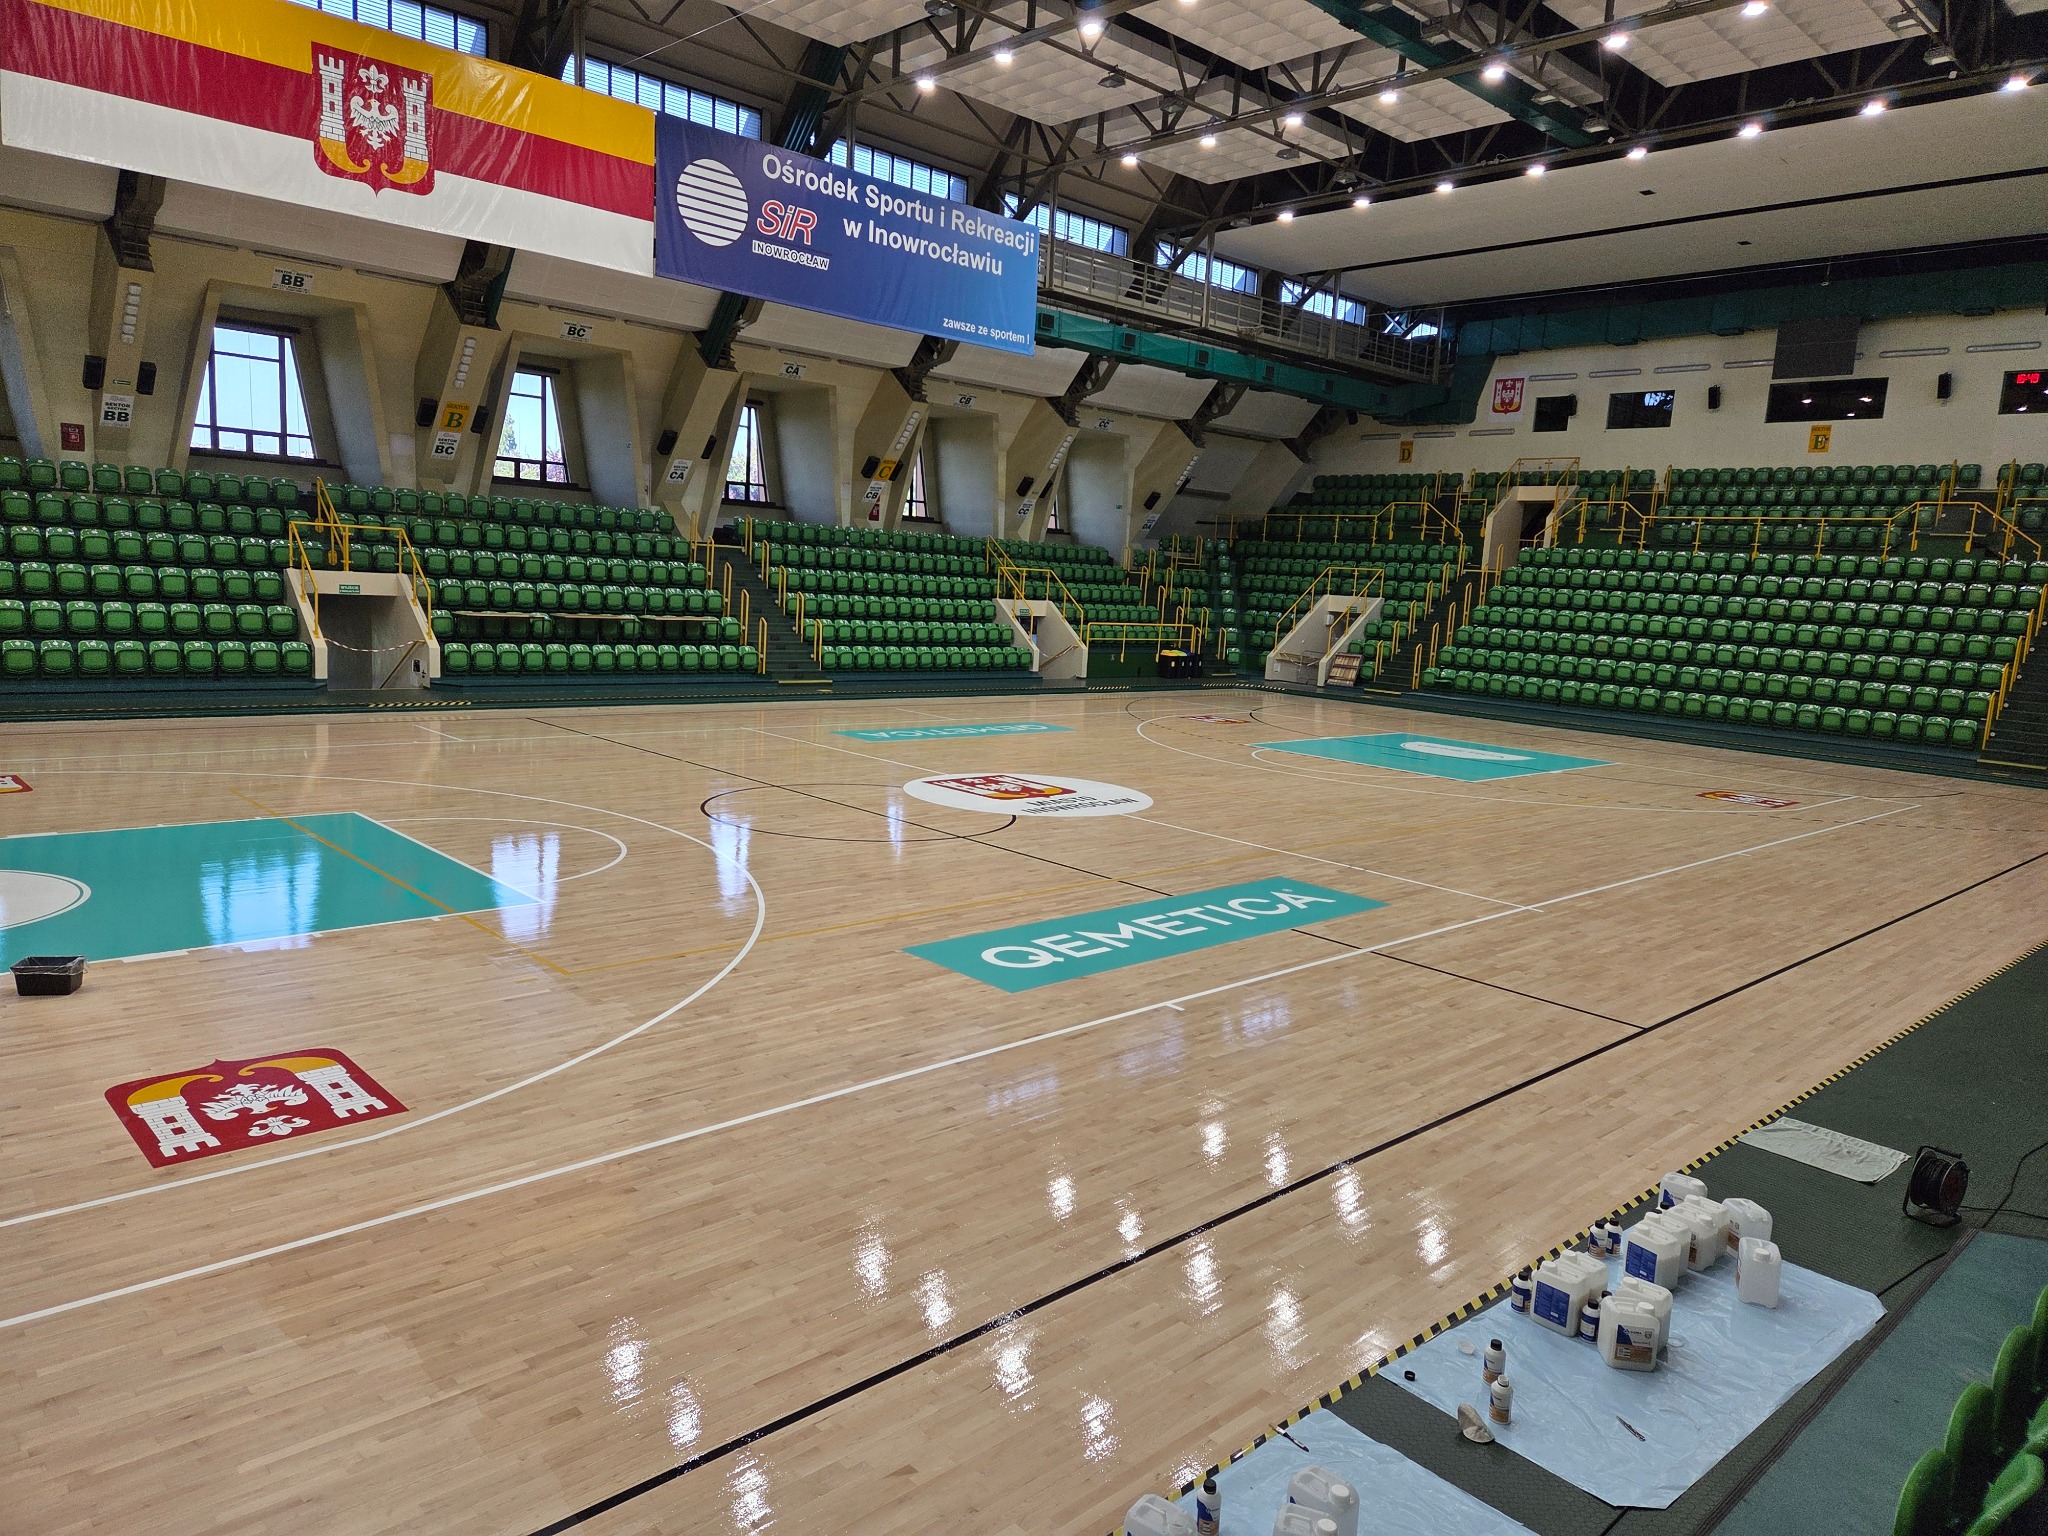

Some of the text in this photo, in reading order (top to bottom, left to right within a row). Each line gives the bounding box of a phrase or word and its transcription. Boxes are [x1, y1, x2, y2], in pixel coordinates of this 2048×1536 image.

[762, 153, 1035, 257] Ośrodek Sportu i Rekreacji
[756, 200, 818, 246] SiR
[843, 218, 1003, 276] w Inowrocławiu
[753, 240, 830, 270] INOWROCŁAW
[281, 273, 305, 287] BB
[567, 326, 586, 337] BC
[942, 317, 976, 334] zawsze
[977, 325, 988, 336] ze
[990, 326, 1025, 344] sportem
[786, 365, 800, 375] CA
[103, 410, 130, 422] BB
[446, 412, 465, 428] B
[1812, 434, 1827, 449] E
[434, 444, 455, 455] BC
[1402, 449, 1411, 461] D
[669, 471, 684, 480] CA
[878, 465, 892, 478] C
[865, 491, 879, 499] CB
[981, 890, 1337, 968] QEMETICA
